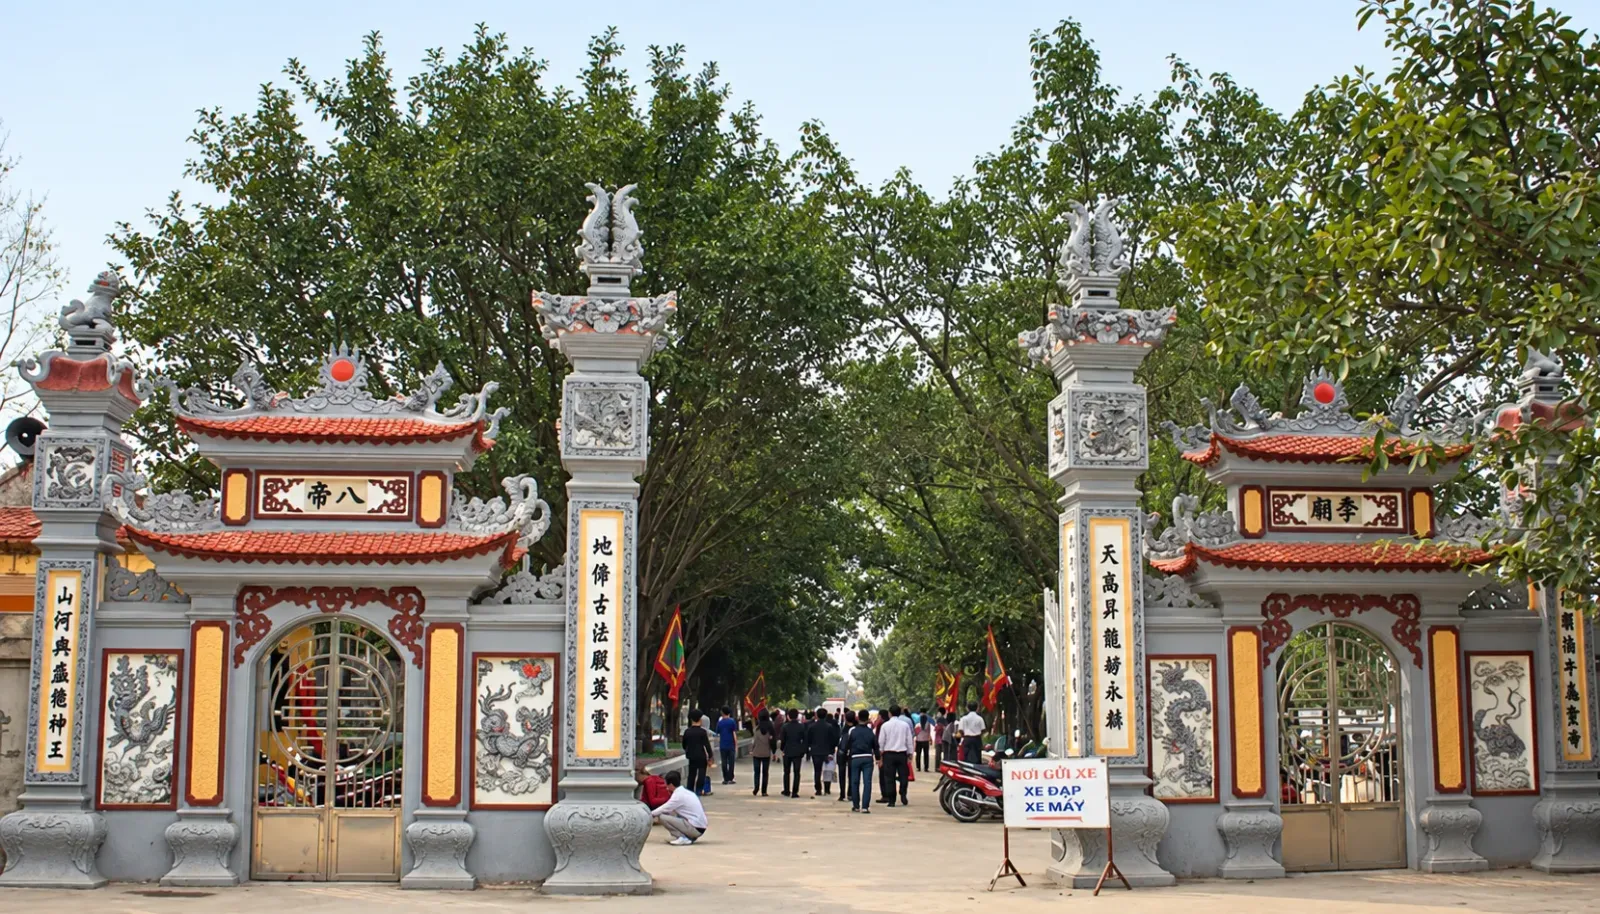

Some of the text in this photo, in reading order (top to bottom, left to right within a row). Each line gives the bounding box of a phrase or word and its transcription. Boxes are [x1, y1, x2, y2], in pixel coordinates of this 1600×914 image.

[1011, 765, 1097, 780] NƠI GỬI XE
[1024, 785, 1081, 798] XE ĐẠP
[1025, 798, 1085, 812] XE MÁY
